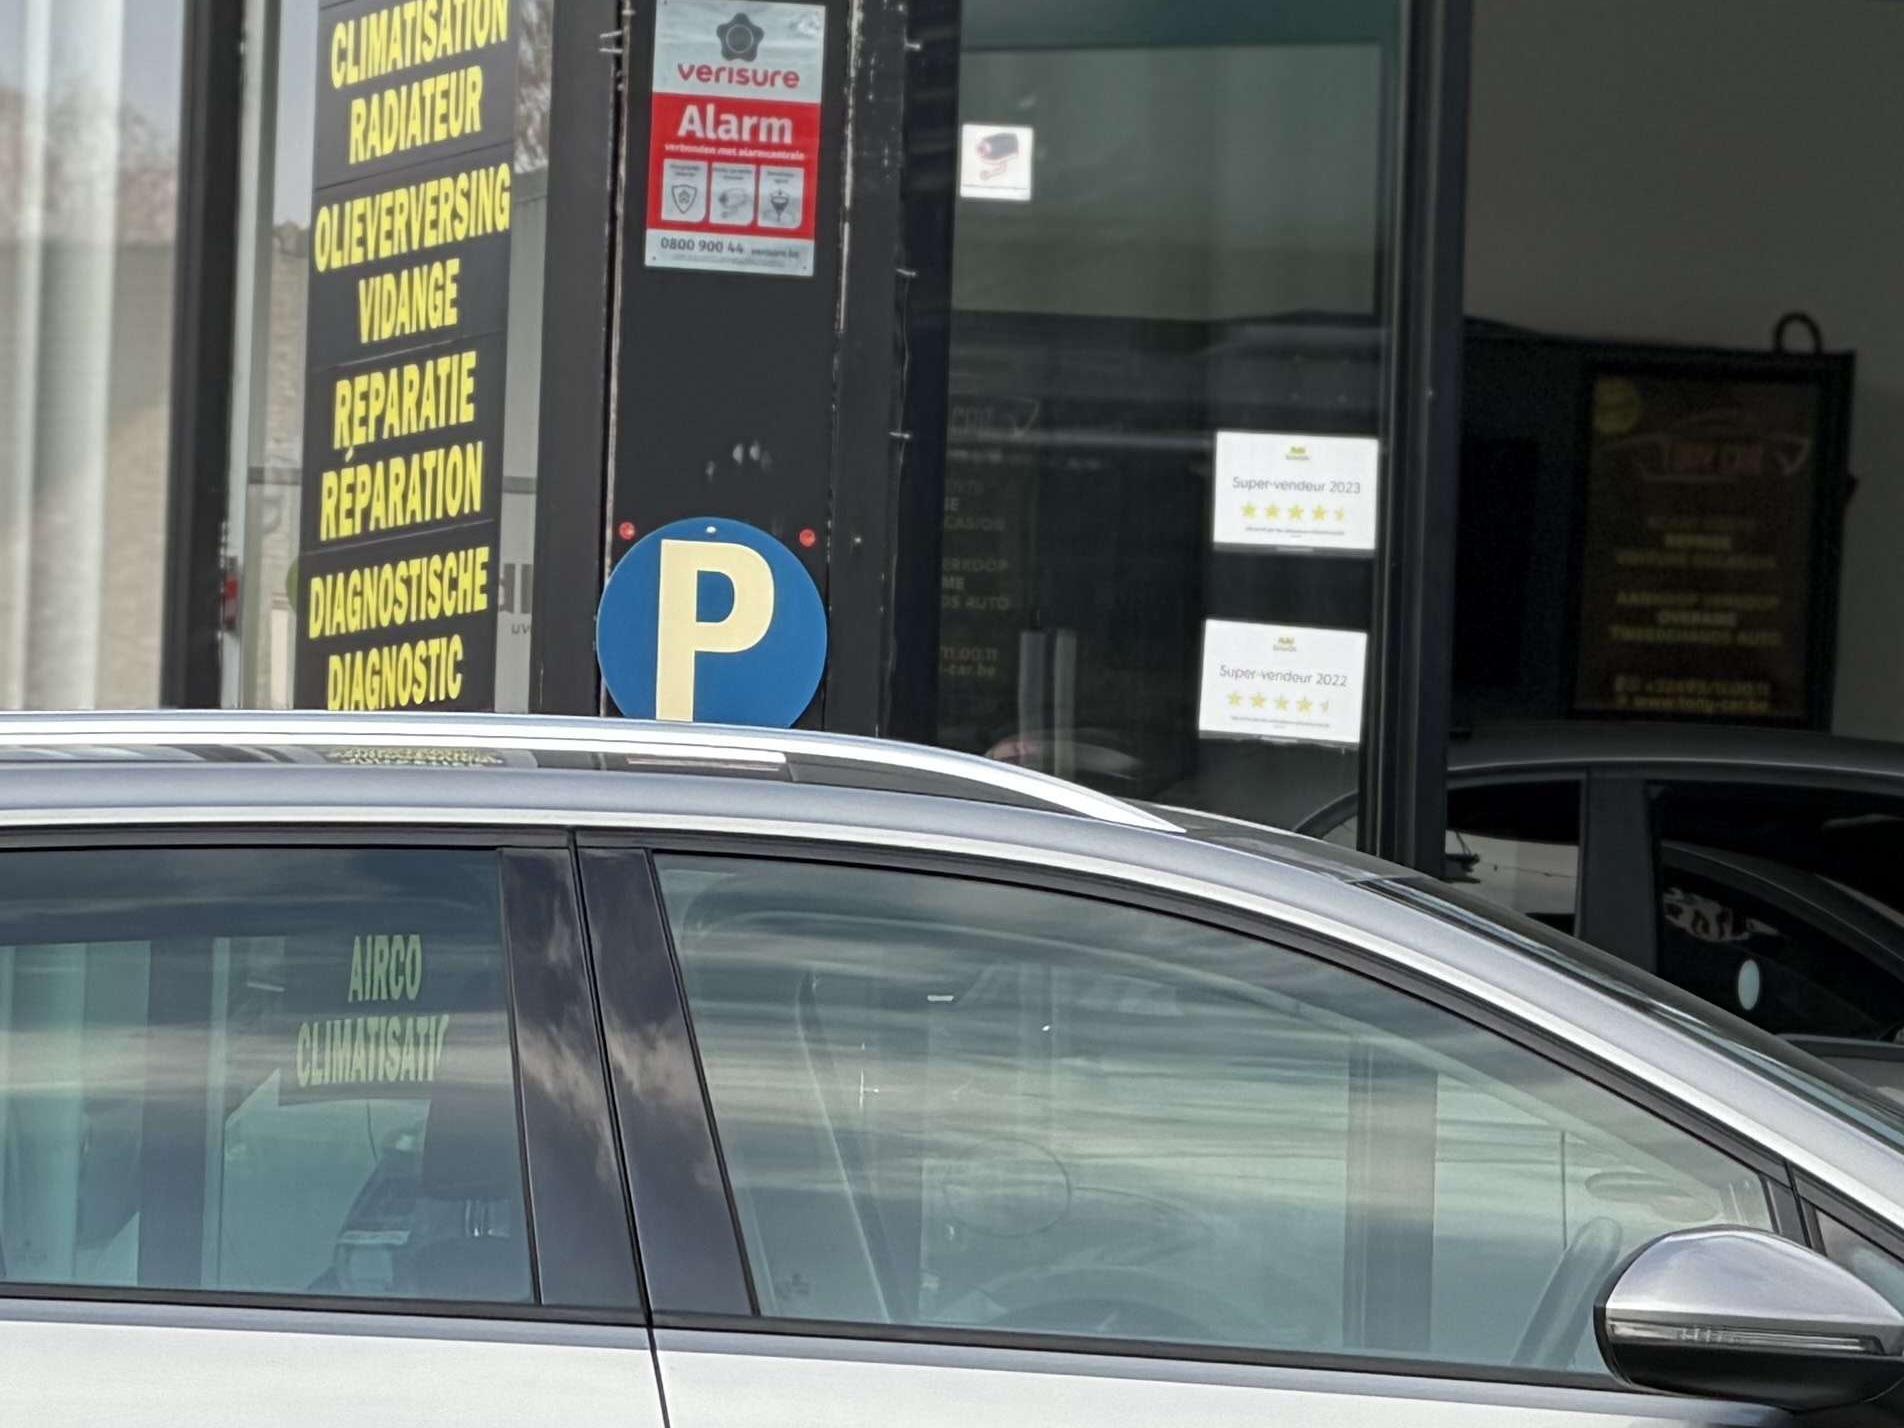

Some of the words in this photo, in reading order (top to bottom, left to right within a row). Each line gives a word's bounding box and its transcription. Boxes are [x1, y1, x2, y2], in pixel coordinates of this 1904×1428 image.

[348, 66, 483, 164] RADIATEUR
[677, 63, 801, 89] verisure
[677, 103, 794, 145] Alarm
[313, 163, 511, 272] OLIEVERVERSING
[660, 236, 696, 251] 0800
[698, 239, 724, 253] 900
[358, 258, 460, 345] VIDANGE
[333, 350, 477, 449] REPARATIE
[319, 441, 483, 542] RÉPARATION
[1232, 476, 1327, 493] Super-vendeur
[1328, 479, 1362, 494] 2023
[308, 546, 489, 639] DIAGNOSTISCHE
[656, 538, 775, 721] P
[327, 634, 464, 712] DIAGNOSTIC
[1218, 663, 1313, 683] Super-vendeur
[1315, 672, 1349, 687] 2022
[348, 933, 423, 1004] AIRCO
[297, 1013, 450, 1087] CLIMATISATI
